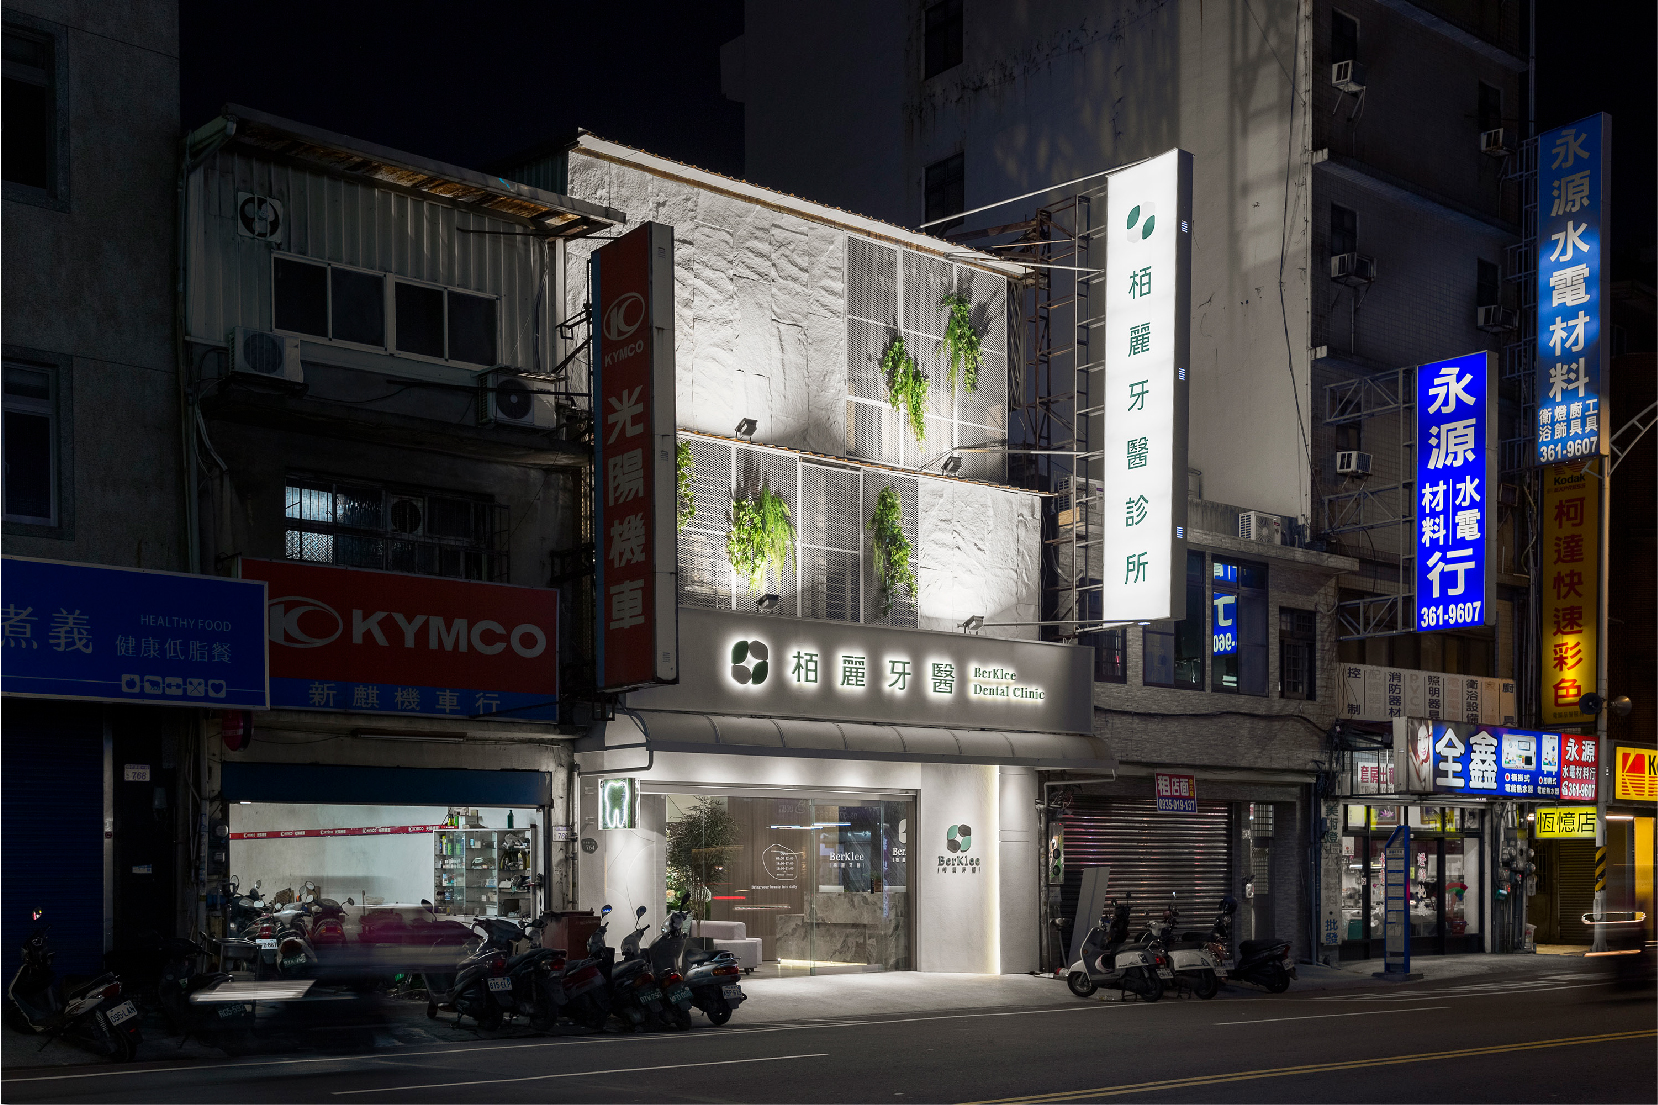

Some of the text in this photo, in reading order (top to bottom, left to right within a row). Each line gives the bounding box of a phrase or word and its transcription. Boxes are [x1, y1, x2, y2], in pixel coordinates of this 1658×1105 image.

[603, 340, 645, 367] KYMCO
[1124, 265, 1153, 586] 栢麗牙醫診所
[1427, 367, 1477, 470] 永源
[1540, 436, 1598, 463] 361-9607
[1553, 474, 1586, 486] Kodak
[606, 384, 647, 631] 光陽機車
[1420, 601, 1482, 627] 361-9607
[1552, 496, 1586, 708] 柯達快速彩色
[1, 603, 93, 654] 煮義
[140, 614, 232, 632] HEALTHY FOOD
[352, 609, 547, 658] KYMCO
[115, 634, 232, 663] 健康低脂餐
[791, 651, 956, 694] 栢麗牙醫
[308, 682, 501, 715] 新麒機車行
[973, 683, 1046, 701] Dental Clinic
[1388, 671, 1402, 718] 消防器材
[1435, 727, 1498, 790] 全鑫
[1565, 738, 1596, 763] 永源
[1562, 765, 1596, 781] 水電材料行
[829, 852, 864, 861] BerKlee
[937, 855, 980, 866] BerKlee
[1325, 918, 1339, 945] 批發
